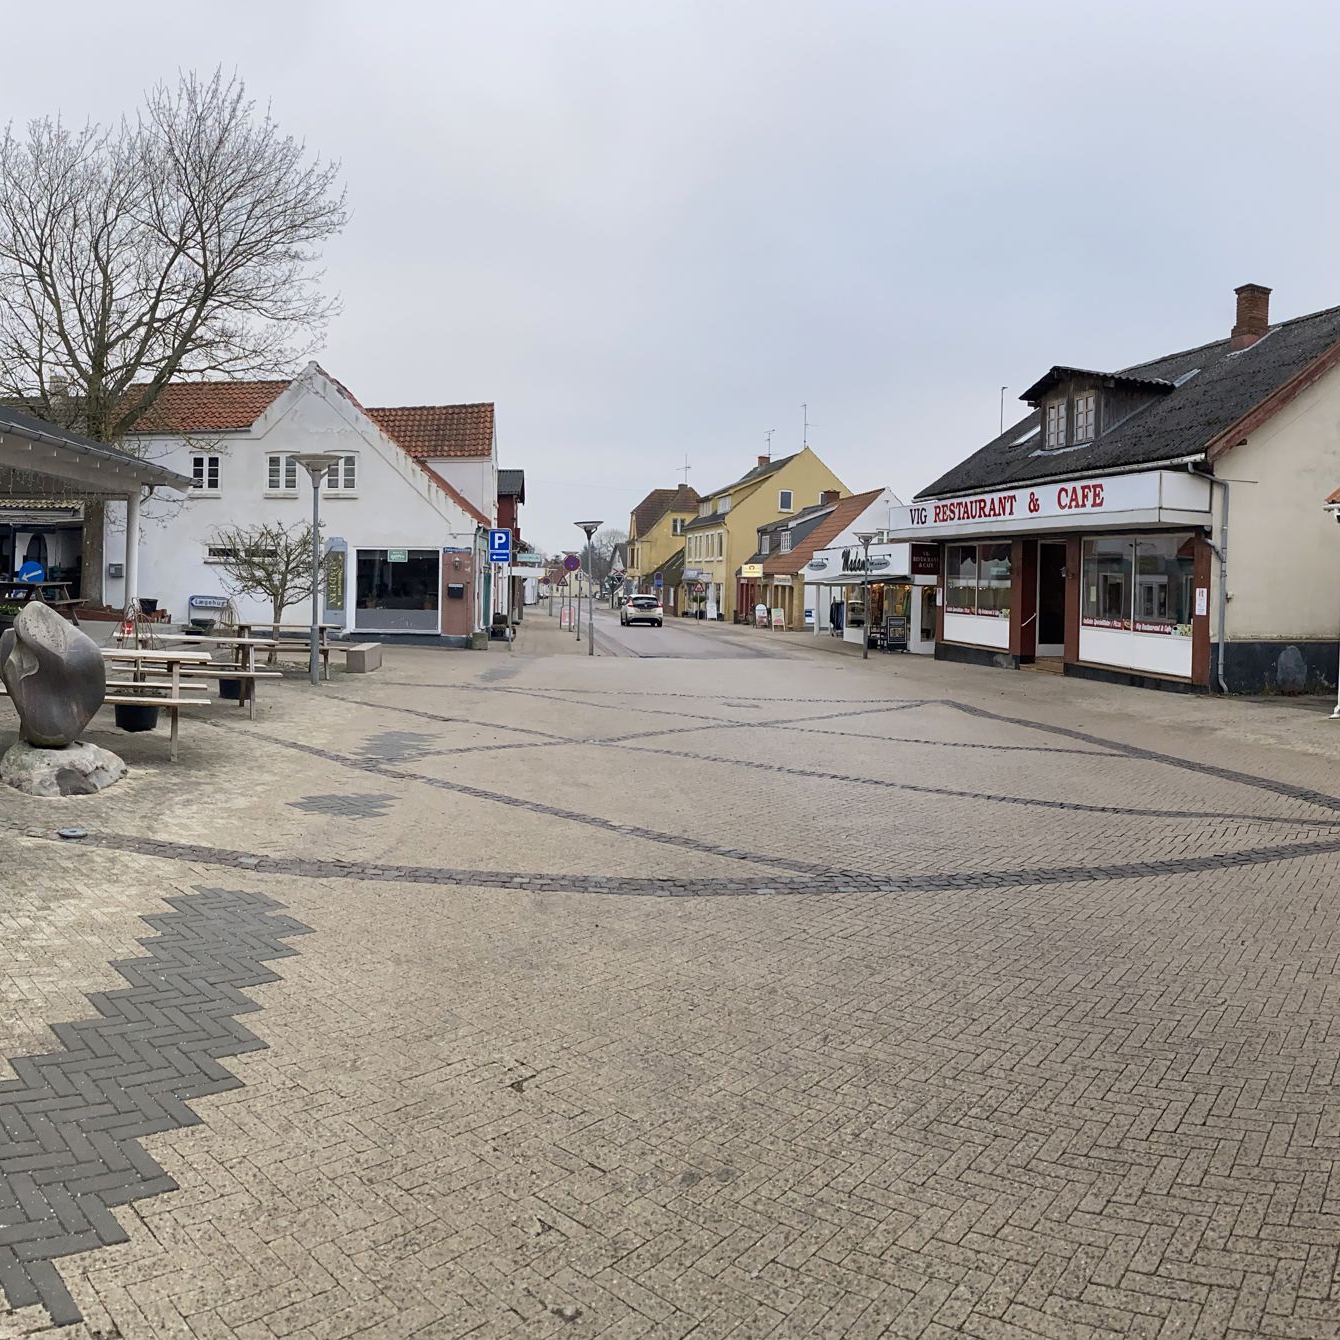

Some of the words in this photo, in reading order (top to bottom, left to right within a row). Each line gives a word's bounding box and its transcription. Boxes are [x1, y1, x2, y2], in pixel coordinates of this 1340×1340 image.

[910, 507, 927, 525] VIG
[933, 494, 1017, 523] RESTAURANT
[1028, 491, 1040, 513] &
[1057, 483, 1105, 510] CAFE
[494, 533, 506, 549] P
